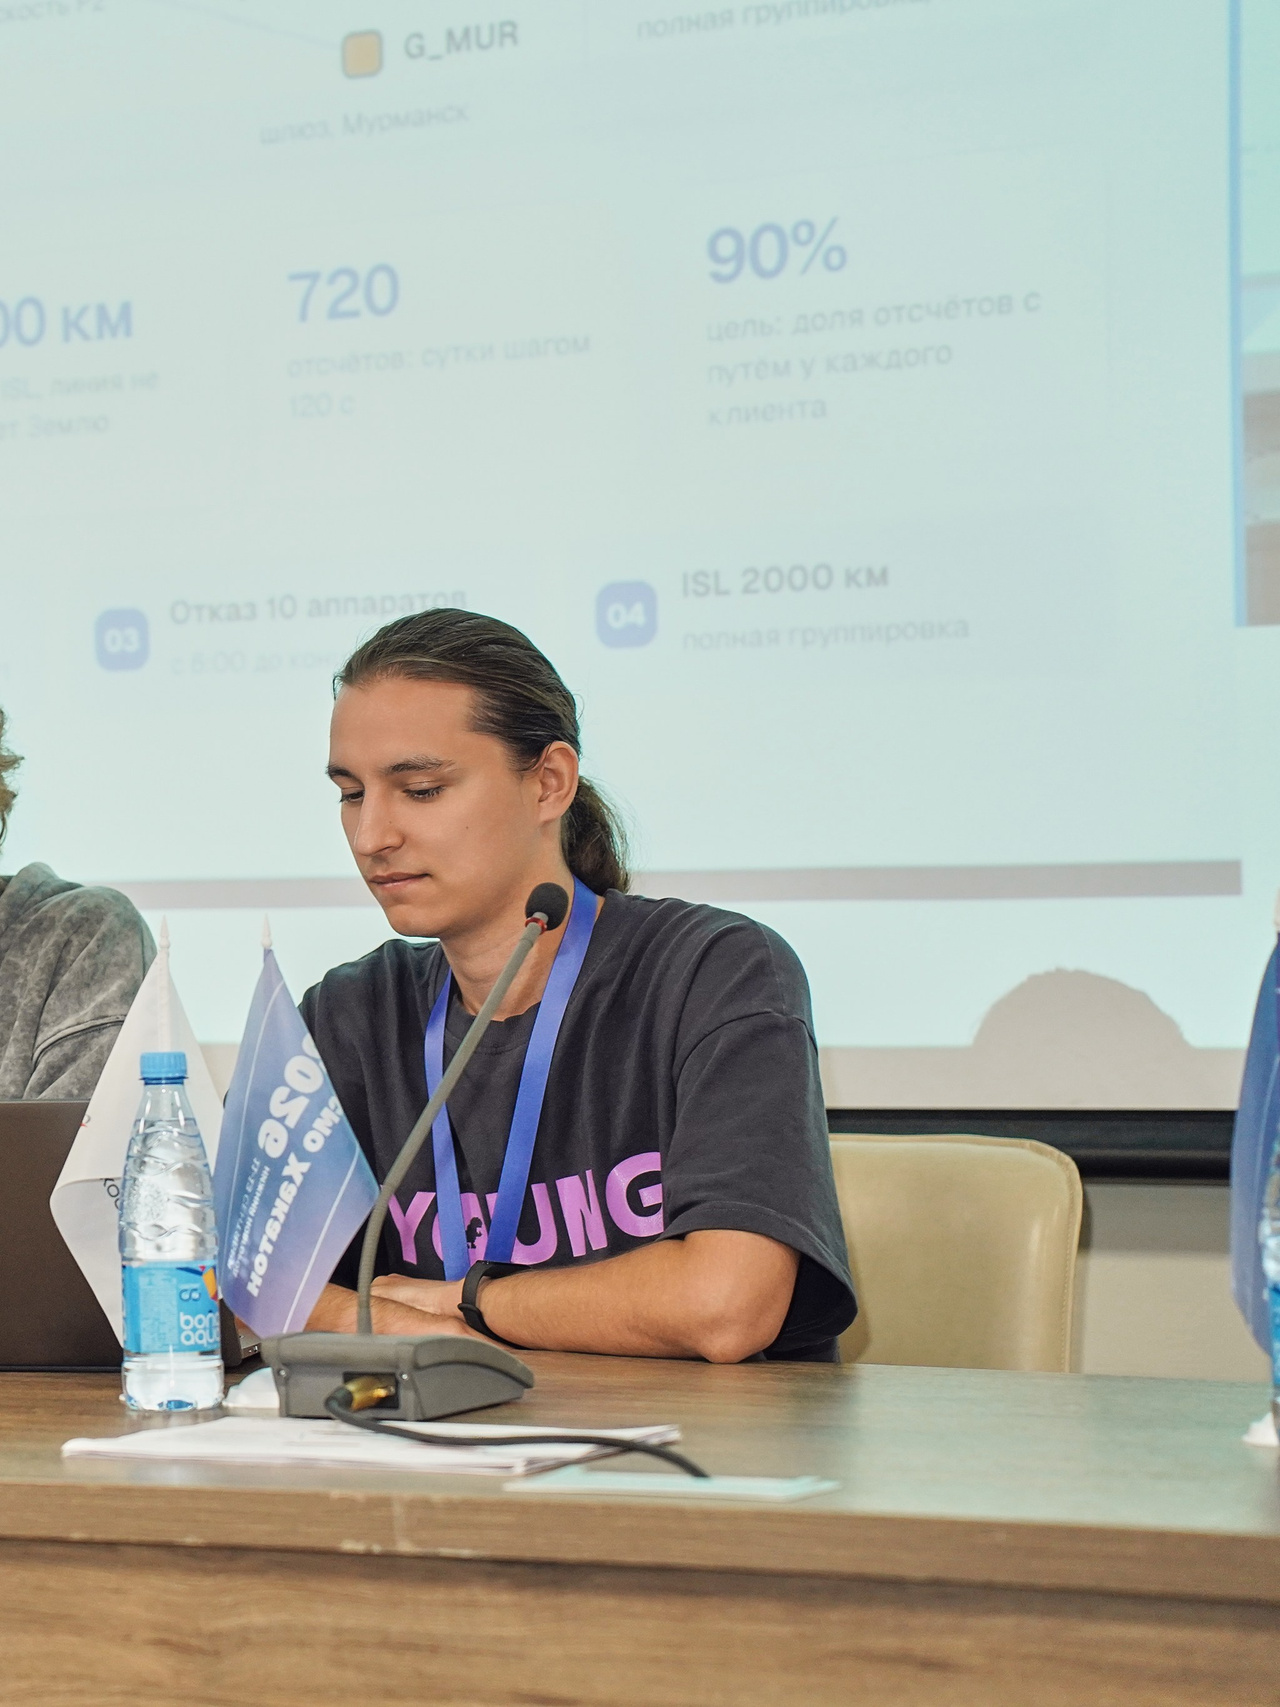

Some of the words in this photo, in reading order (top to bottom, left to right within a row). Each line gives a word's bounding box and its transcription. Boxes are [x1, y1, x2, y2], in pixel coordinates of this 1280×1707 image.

[403, 20, 519, 61] G_MUR
[636, 8, 735, 40] полная
[342, 103, 469, 137] Мурманск
[706, 216, 848, 285] 90%
[287, 263, 400, 323] 720
[706, 313, 782, 342] цель:
[791, 307, 865, 336] доля
[873, 293, 1014, 328] отсчётов
[1023, 291, 1042, 313] с
[421, 342, 495, 372] сутки
[504, 335, 591, 361] шагом
[707, 357, 792, 388] путём
[801, 356, 816, 382] у
[825, 343, 954, 373] каждого
[707, 398, 828, 427] клиента
[682, 569, 730, 598] ISL
[741, 563, 834, 595] 2000
[169, 598, 258, 626] Отказ
[268, 592, 299, 621] 10
[606, 600, 647, 630] 04
[104, 627, 140, 654] 03
[683, 624, 781, 652] полная
[789, 616, 970, 649] группировка
[382, 1150, 665, 1265] YOUNG
